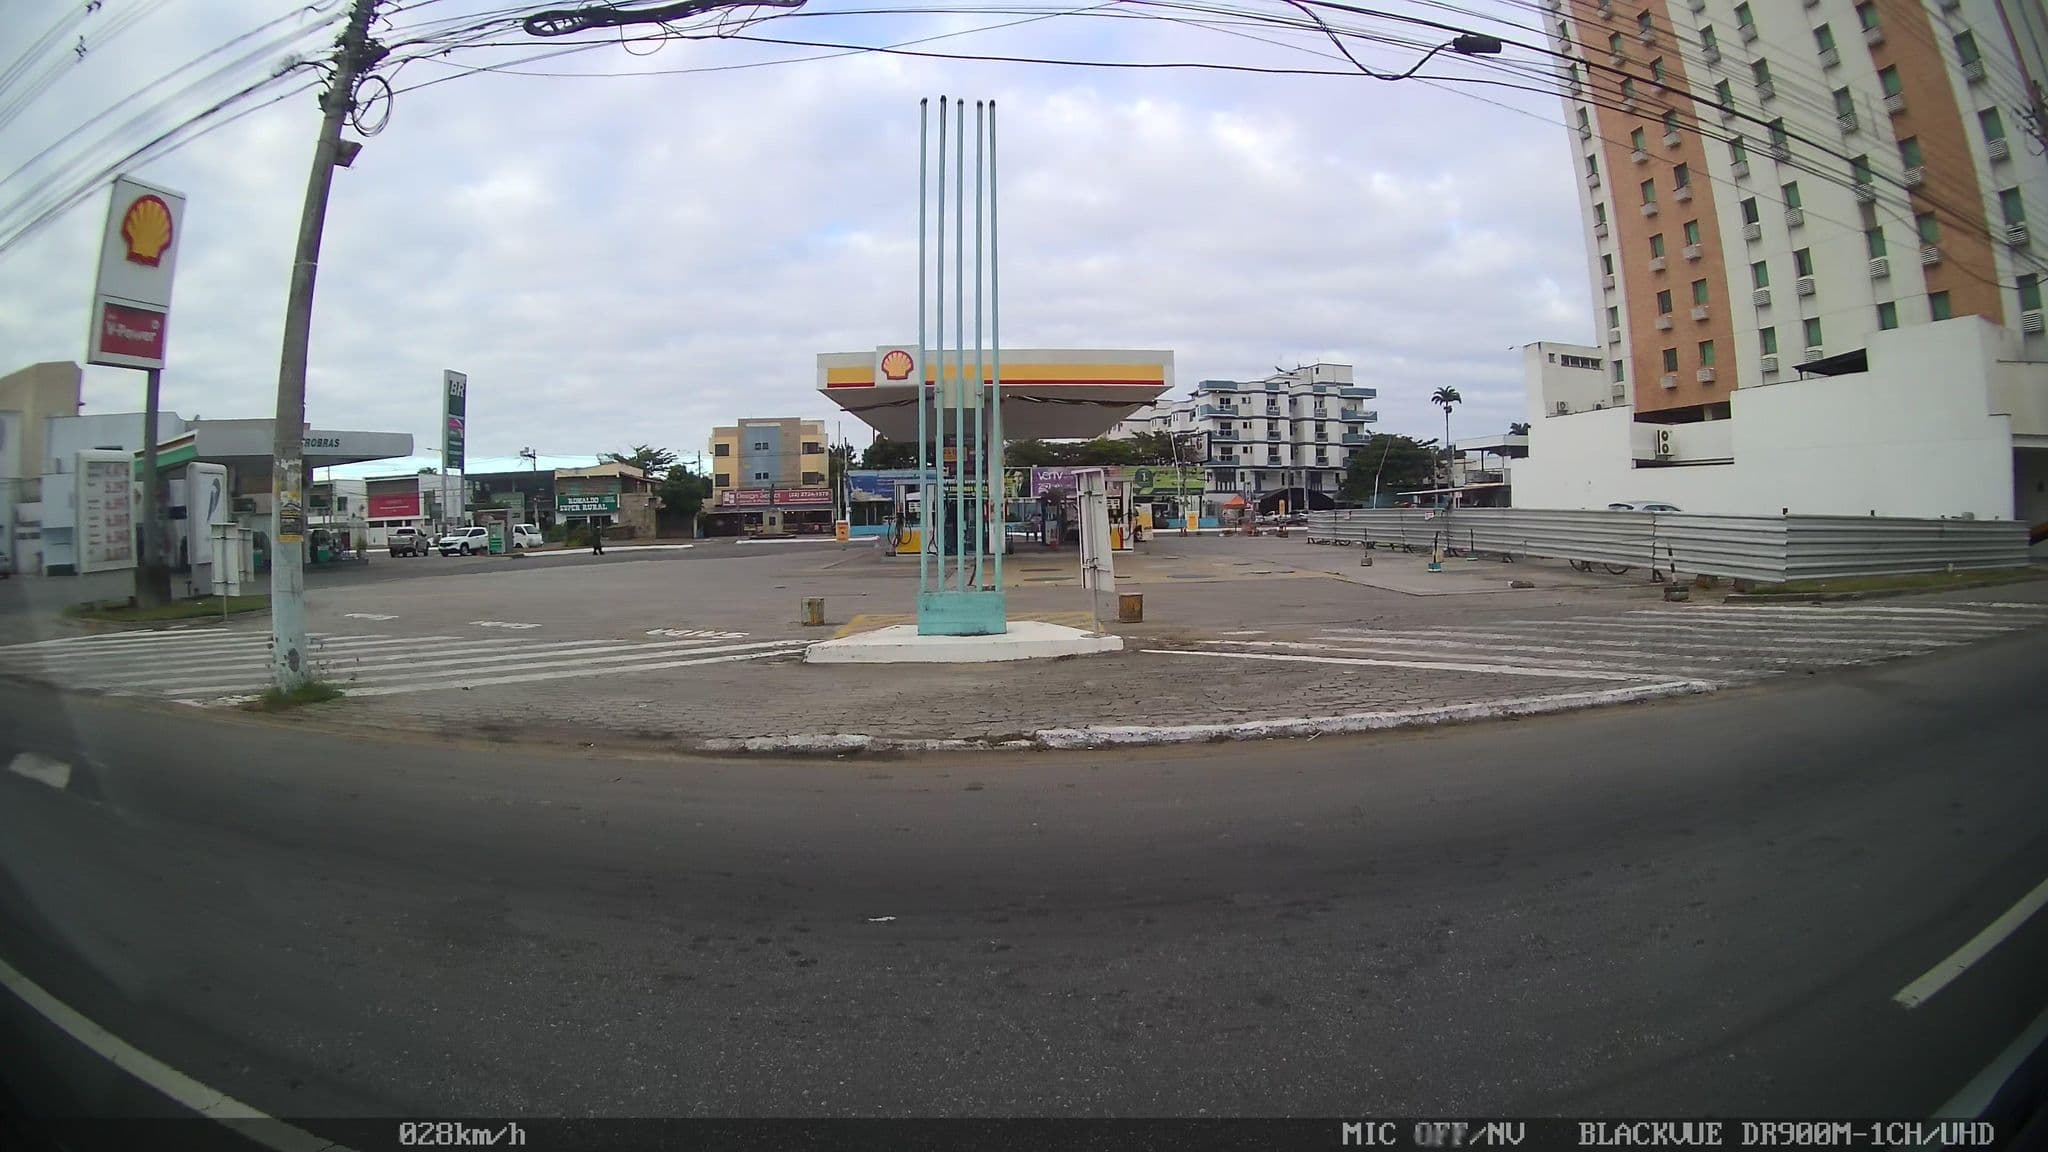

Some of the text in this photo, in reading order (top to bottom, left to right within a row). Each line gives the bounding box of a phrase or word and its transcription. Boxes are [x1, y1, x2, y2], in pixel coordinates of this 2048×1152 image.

[106, 321, 157, 342] V-Power
[450, 381, 464, 398] BR
[568, 496, 599, 504] RONALDO
[582, 503, 608, 511] RURAL
